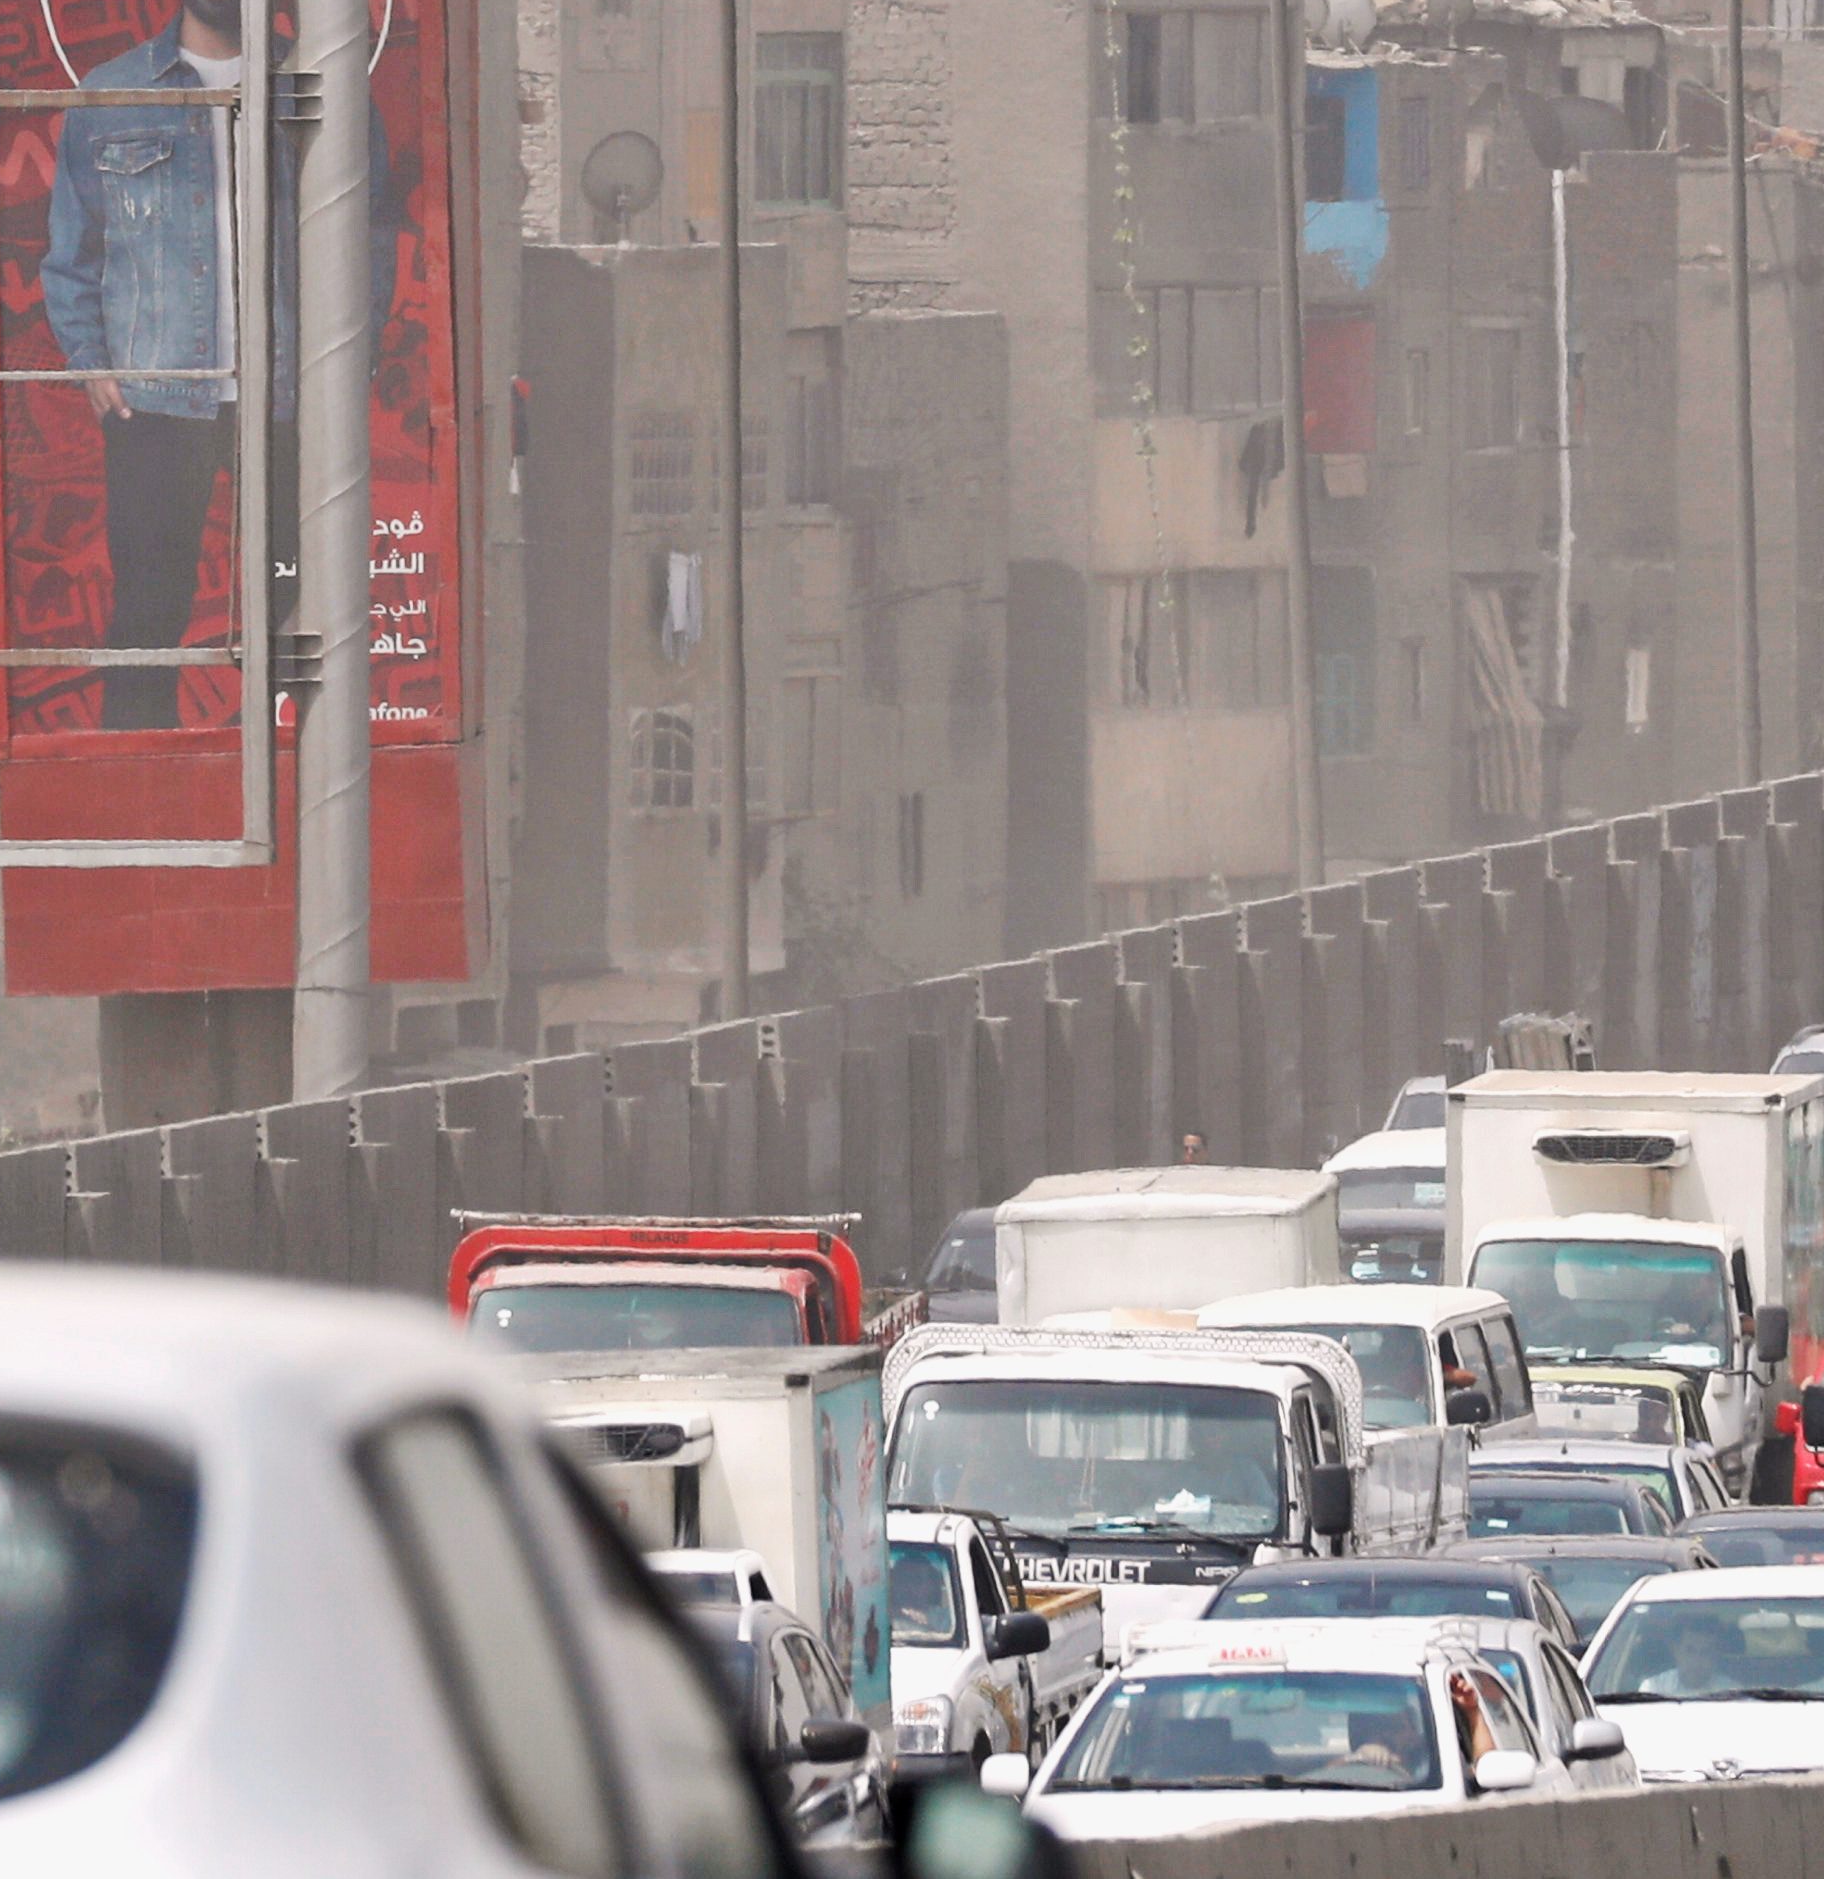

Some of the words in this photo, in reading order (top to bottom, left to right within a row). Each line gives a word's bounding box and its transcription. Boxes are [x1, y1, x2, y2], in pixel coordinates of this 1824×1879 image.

[389, 598, 426, 623] اللي
[368, 632, 427, 660] جاه
[368, 701, 428, 721] afone
